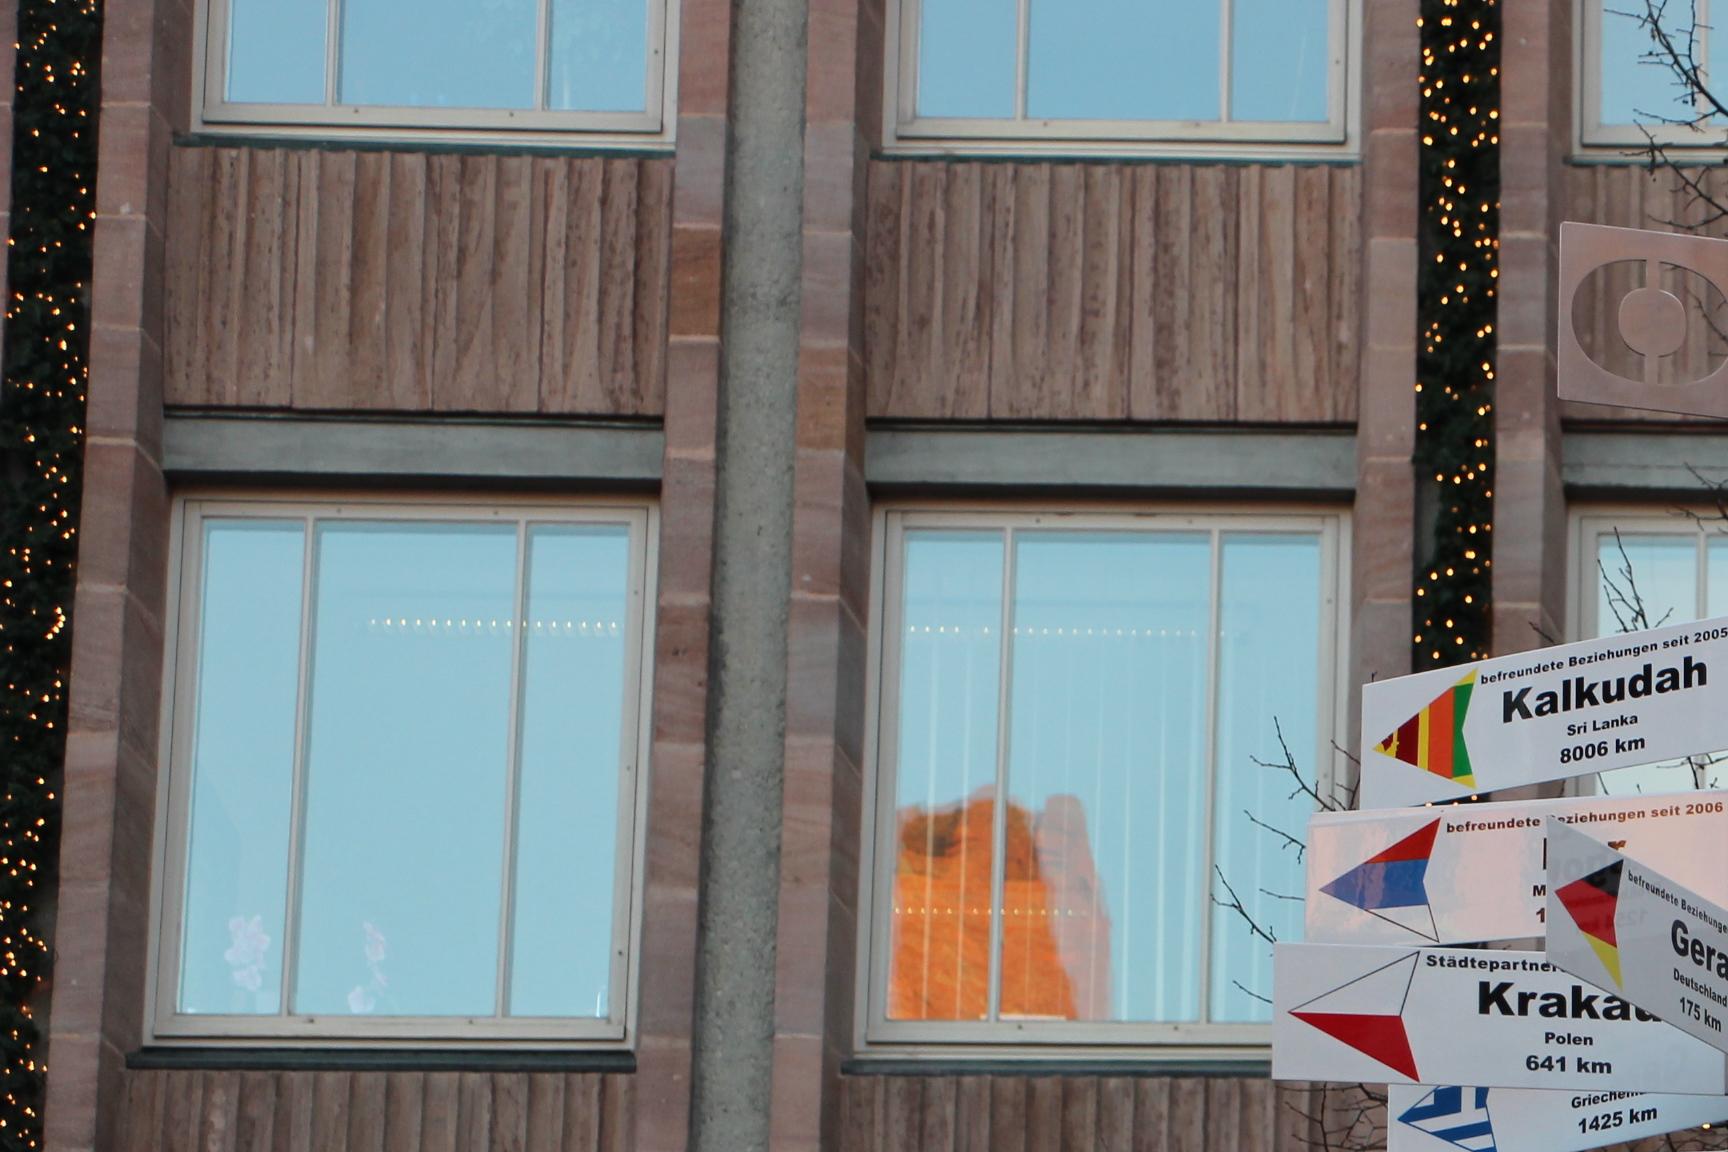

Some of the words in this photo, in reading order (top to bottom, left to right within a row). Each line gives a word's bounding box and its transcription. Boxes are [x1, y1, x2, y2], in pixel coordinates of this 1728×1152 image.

[1481, 661, 1564, 684] befreundete
[1569, 643, 1658, 667] Beziehungen
[1662, 635, 1689, 649] seit
[1694, 627, 1728, 643] 2005
[1503, 652, 1707, 726] Kalkudah
[1567, 722, 1587, 736] Sri
[1592, 715, 1638, 732] Lanka
[1560, 741, 1608, 764] 8006
[1615, 738, 1645, 754] km
[1446, 817, 1540, 833] befreundete
[1551, 810, 1645, 823] eziehungen
[1651, 806, 1680, 818] seit
[1686, 802, 1723, 815] 2006
[1628, 869, 1679, 906] befreundete
[1426, 955, 1566, 972] Städtepartne
[1674, 968, 1727, 1008] Deutschland
[1680, 997, 1701, 1021] 175
[1704, 1008, 1721, 1032] km
[1545, 1032, 1593, 1046] Polen
[1526, 1055, 1566, 1072] 641
[1577, 1057, 1612, 1074] km
[1578, 1111, 1623, 1134] 1425
[1629, 1108, 1657, 1124] km
